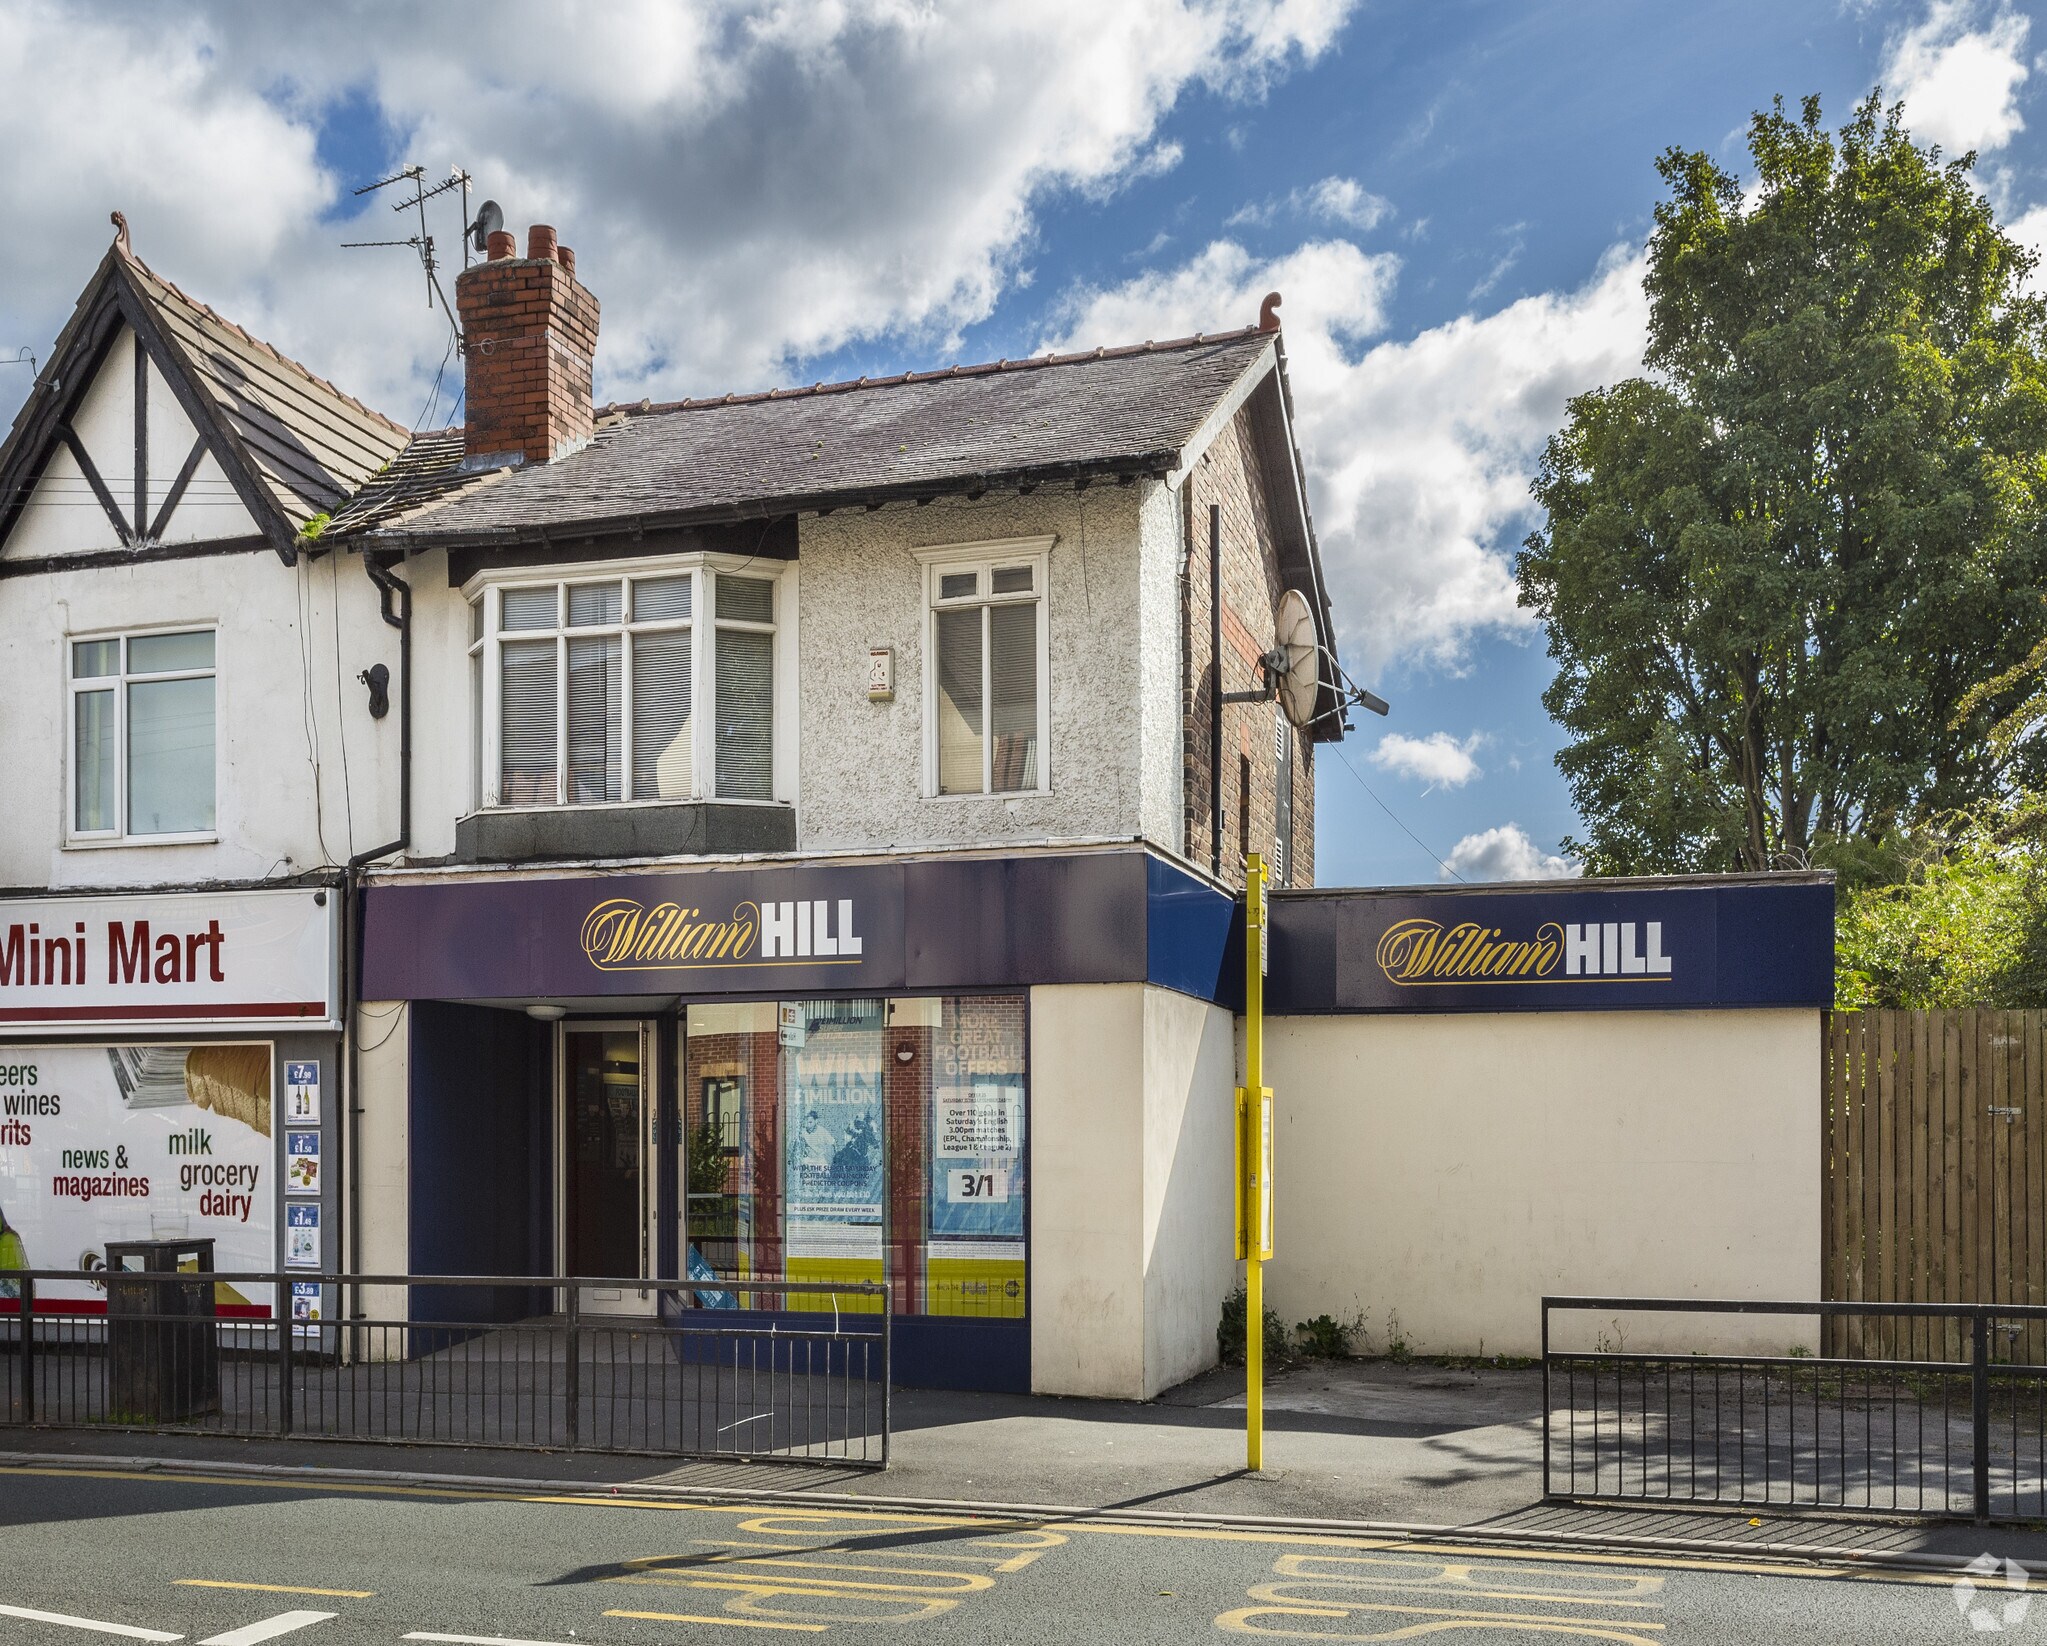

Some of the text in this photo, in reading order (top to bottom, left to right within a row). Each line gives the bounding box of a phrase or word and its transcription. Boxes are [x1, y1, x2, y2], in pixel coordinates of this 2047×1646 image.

[581, 899, 863, 965] William HILL
[0, 920, 225, 986] Mini Mart
[1377, 919, 1672, 980] William HILL
[950, 1029, 1003, 1045] GREAT
[935, 1044, 1018, 1061] FOOTBALL
[796, 1052, 876, 1087] WIN
[945, 1060, 1008, 1076] OFFERS
[4, 1088, 61, 1116] wines
[949, 1109, 966, 1117] Over
[998, 1108, 1005, 1117] in
[1, 1117, 32, 1146] rits
[169, 1128, 212, 1155] milk
[943, 1134, 961, 1144] (EPL,
[949, 1126, 1005, 1135] 3.00pm matches
[62, 1144, 129, 1169] news &
[943, 1144, 968, 1153] League
[180, 1163, 259, 1192] grocery
[810, 1164, 822, 1172] THE
[53, 1171, 149, 1201] magazines
[962, 1174, 993, 1197] 3/1
[200, 1189, 252, 1222] dairy
